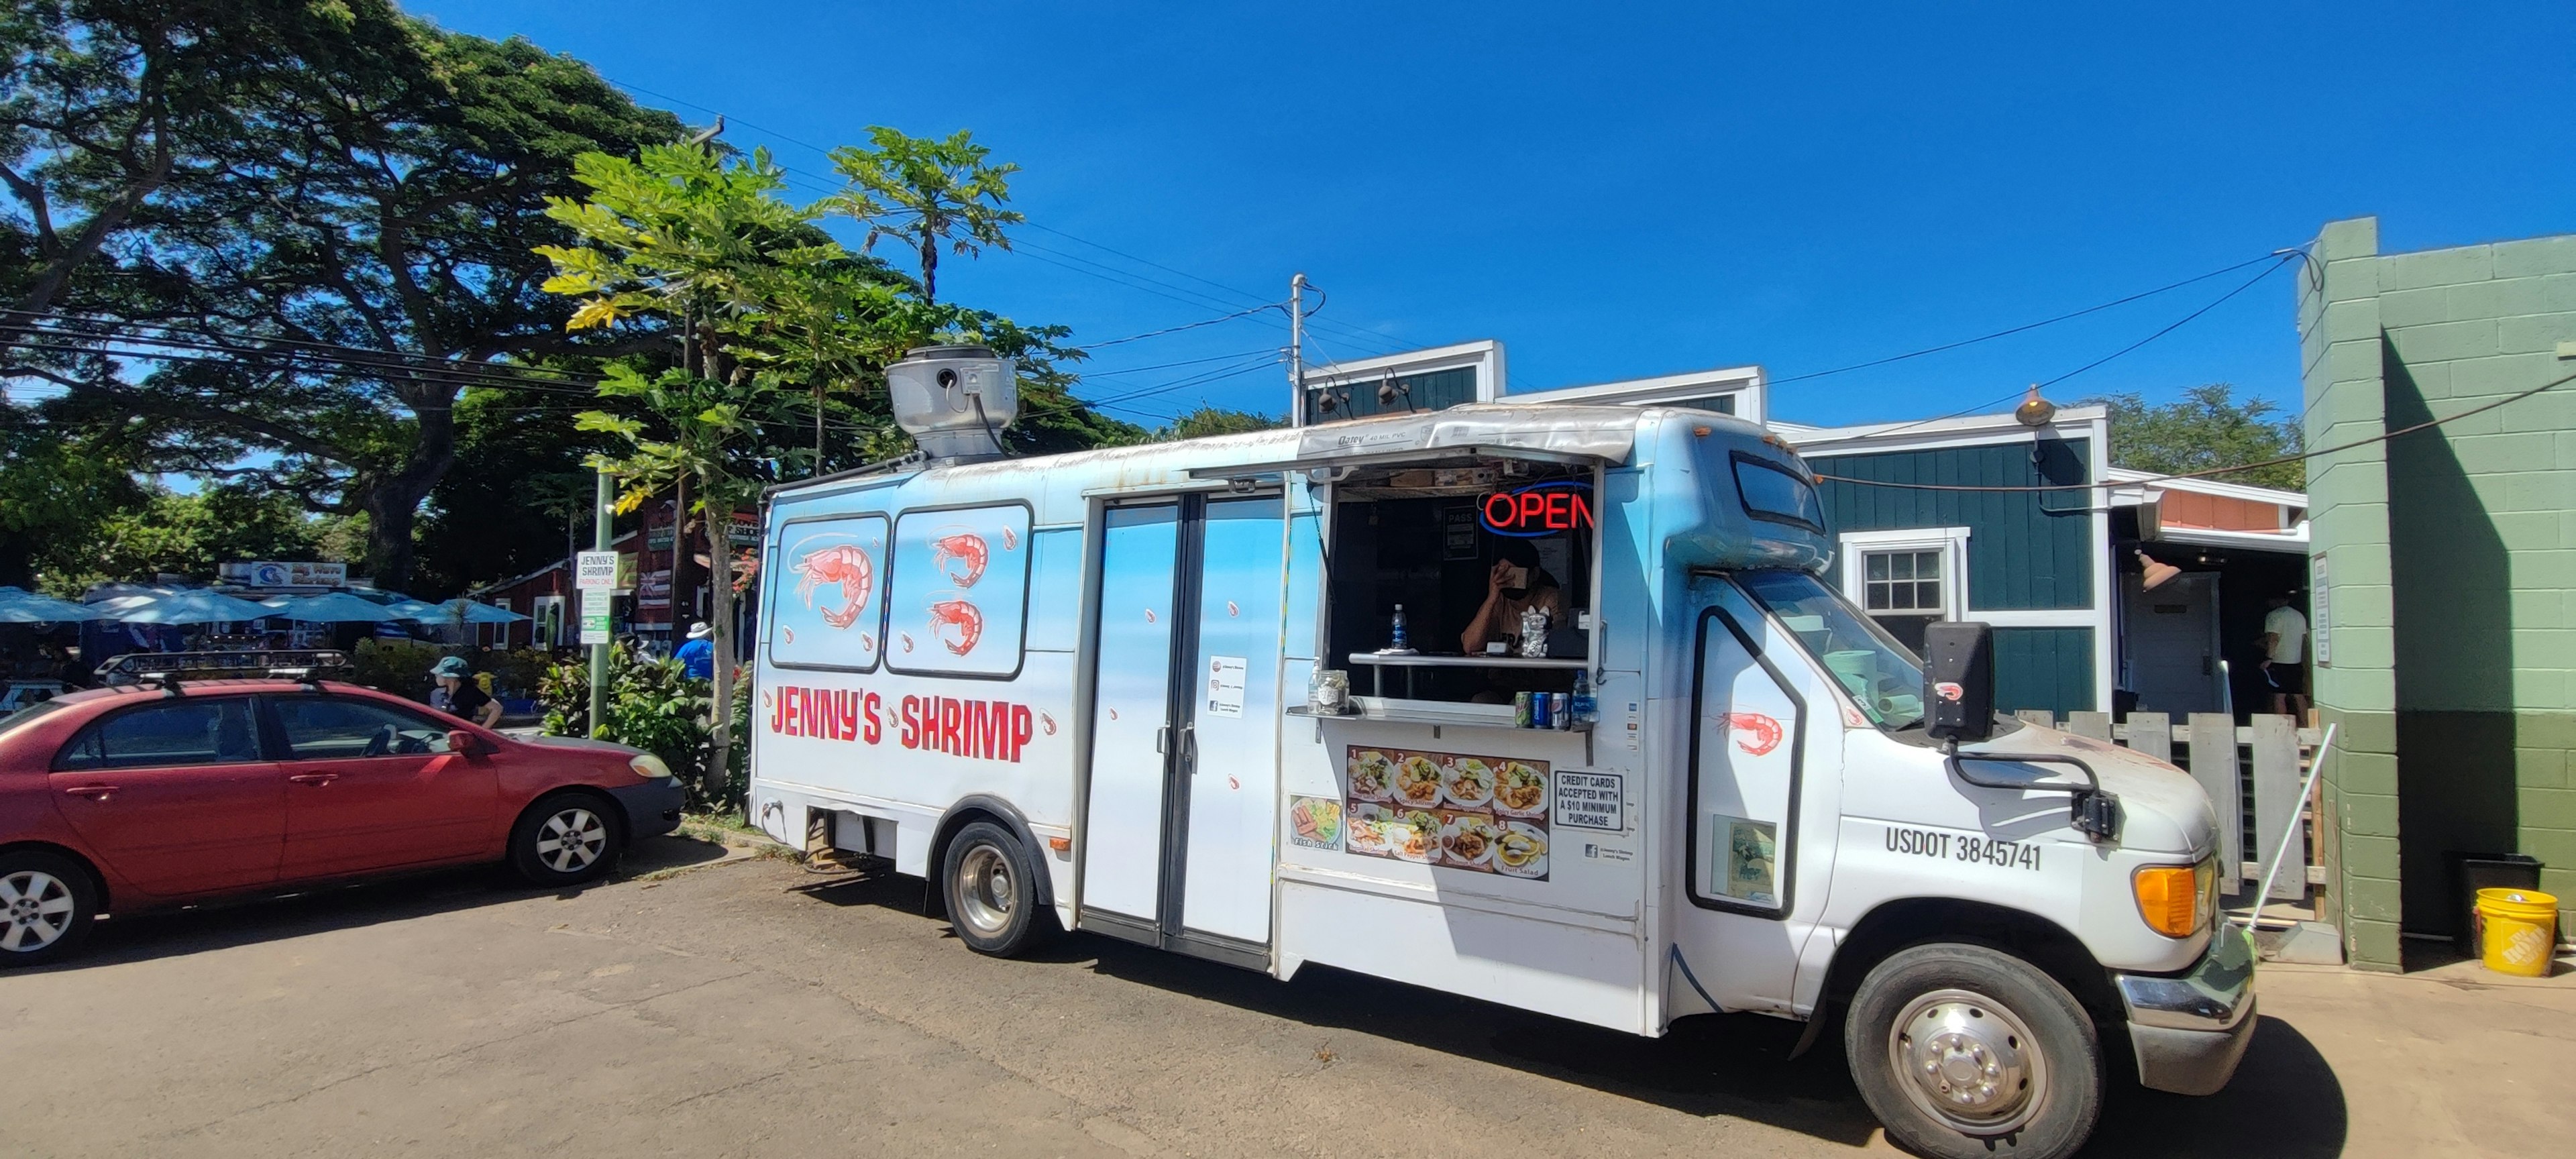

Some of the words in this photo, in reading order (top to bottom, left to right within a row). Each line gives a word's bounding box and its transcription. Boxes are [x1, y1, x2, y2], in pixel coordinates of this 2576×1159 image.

[1448, 512, 1472, 523] PASS
[581, 555, 614, 565] JENNY'S
[582, 567, 613, 576] SHRIMP
[771, 685, 881, 745] JENNY'S
[901, 694, 1033, 763] SHRIMP
[1351, 749, 1356, 759] 1
[1397, 753, 1404, 763] 2
[1447, 757, 1454, 767] 3
[1499, 762, 1506, 771] 4
[1561, 775, 1588, 786] CREDIT
[1590, 777, 1615, 789] CARDS
[1558, 787, 1597, 799] ACCEPTED
[1599, 790, 1618, 802] WITH
[1399, 797, 1413, 806] Spicy
[1415, 799, 1436, 808] Shrimp
[1560, 799, 1565, 810] A
[1567, 800, 1580, 811] $10
[1582, 802, 1617, 814] MINIMUM
[1350, 804, 1356, 812] 5
[1397, 809, 1403, 818] 6
[1446, 814, 1453, 824] 7
[1568, 813, 1609, 826] PURCHASE
[1499, 820, 1506, 830] 8
[1886, 826, 1951, 859] USDOT
[1956, 835, 2041, 871] 3845741
[1519, 868, 1538, 876] Salad
